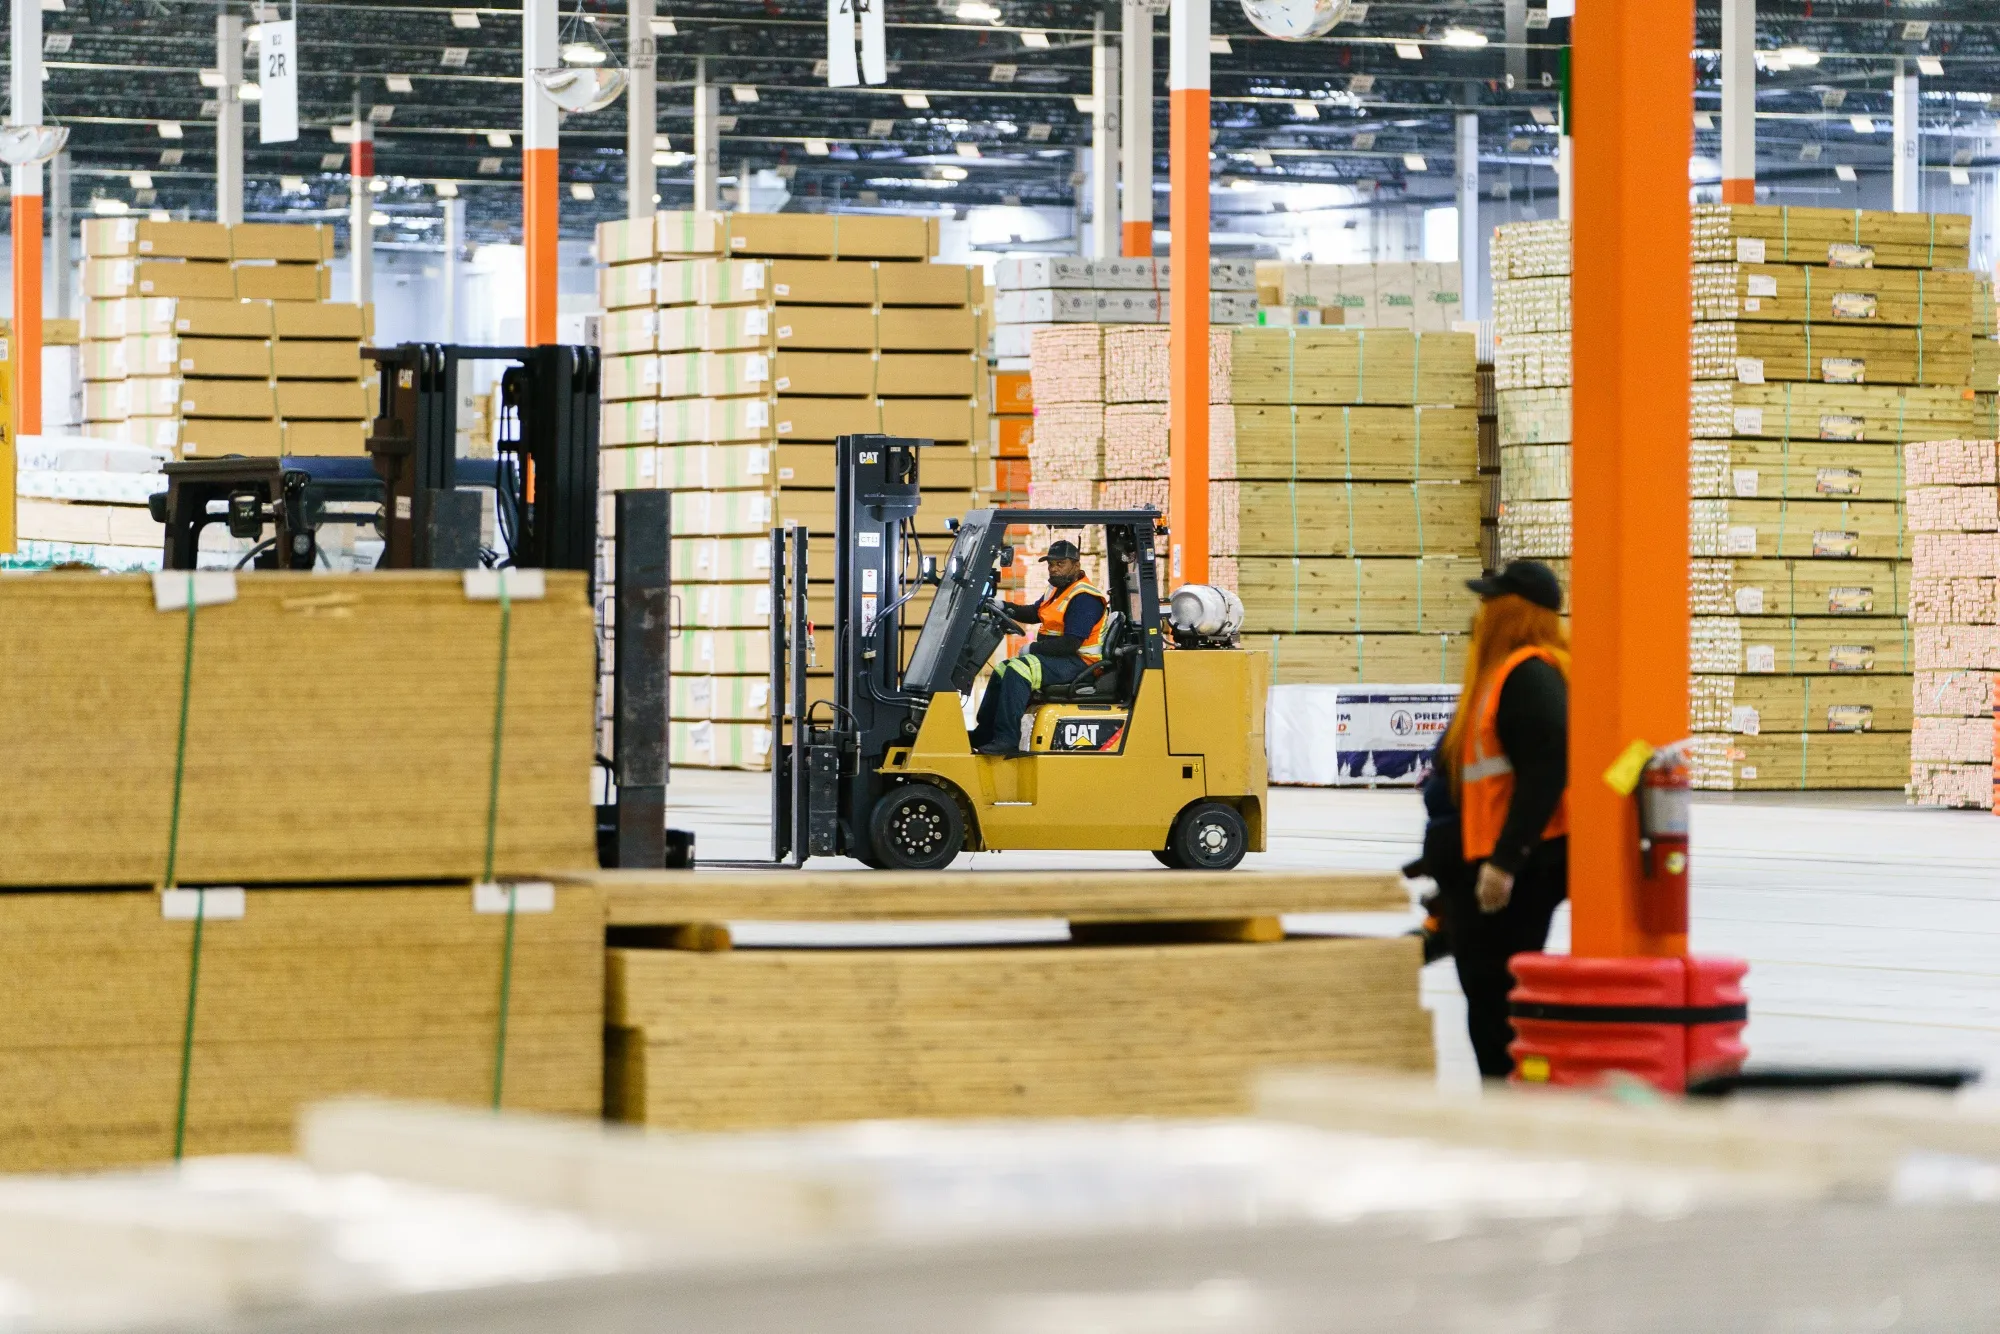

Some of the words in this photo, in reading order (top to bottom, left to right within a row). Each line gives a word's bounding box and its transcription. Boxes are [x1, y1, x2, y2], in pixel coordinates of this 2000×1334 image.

[268, 53, 287, 77] 2R
[398, 369, 413, 388] CAT
[859, 451, 879, 464] CAT
[1414, 712, 1453, 721] PREMI
[1415, 722, 1447, 731] TREA
[1064, 723, 1100, 747] CAT
